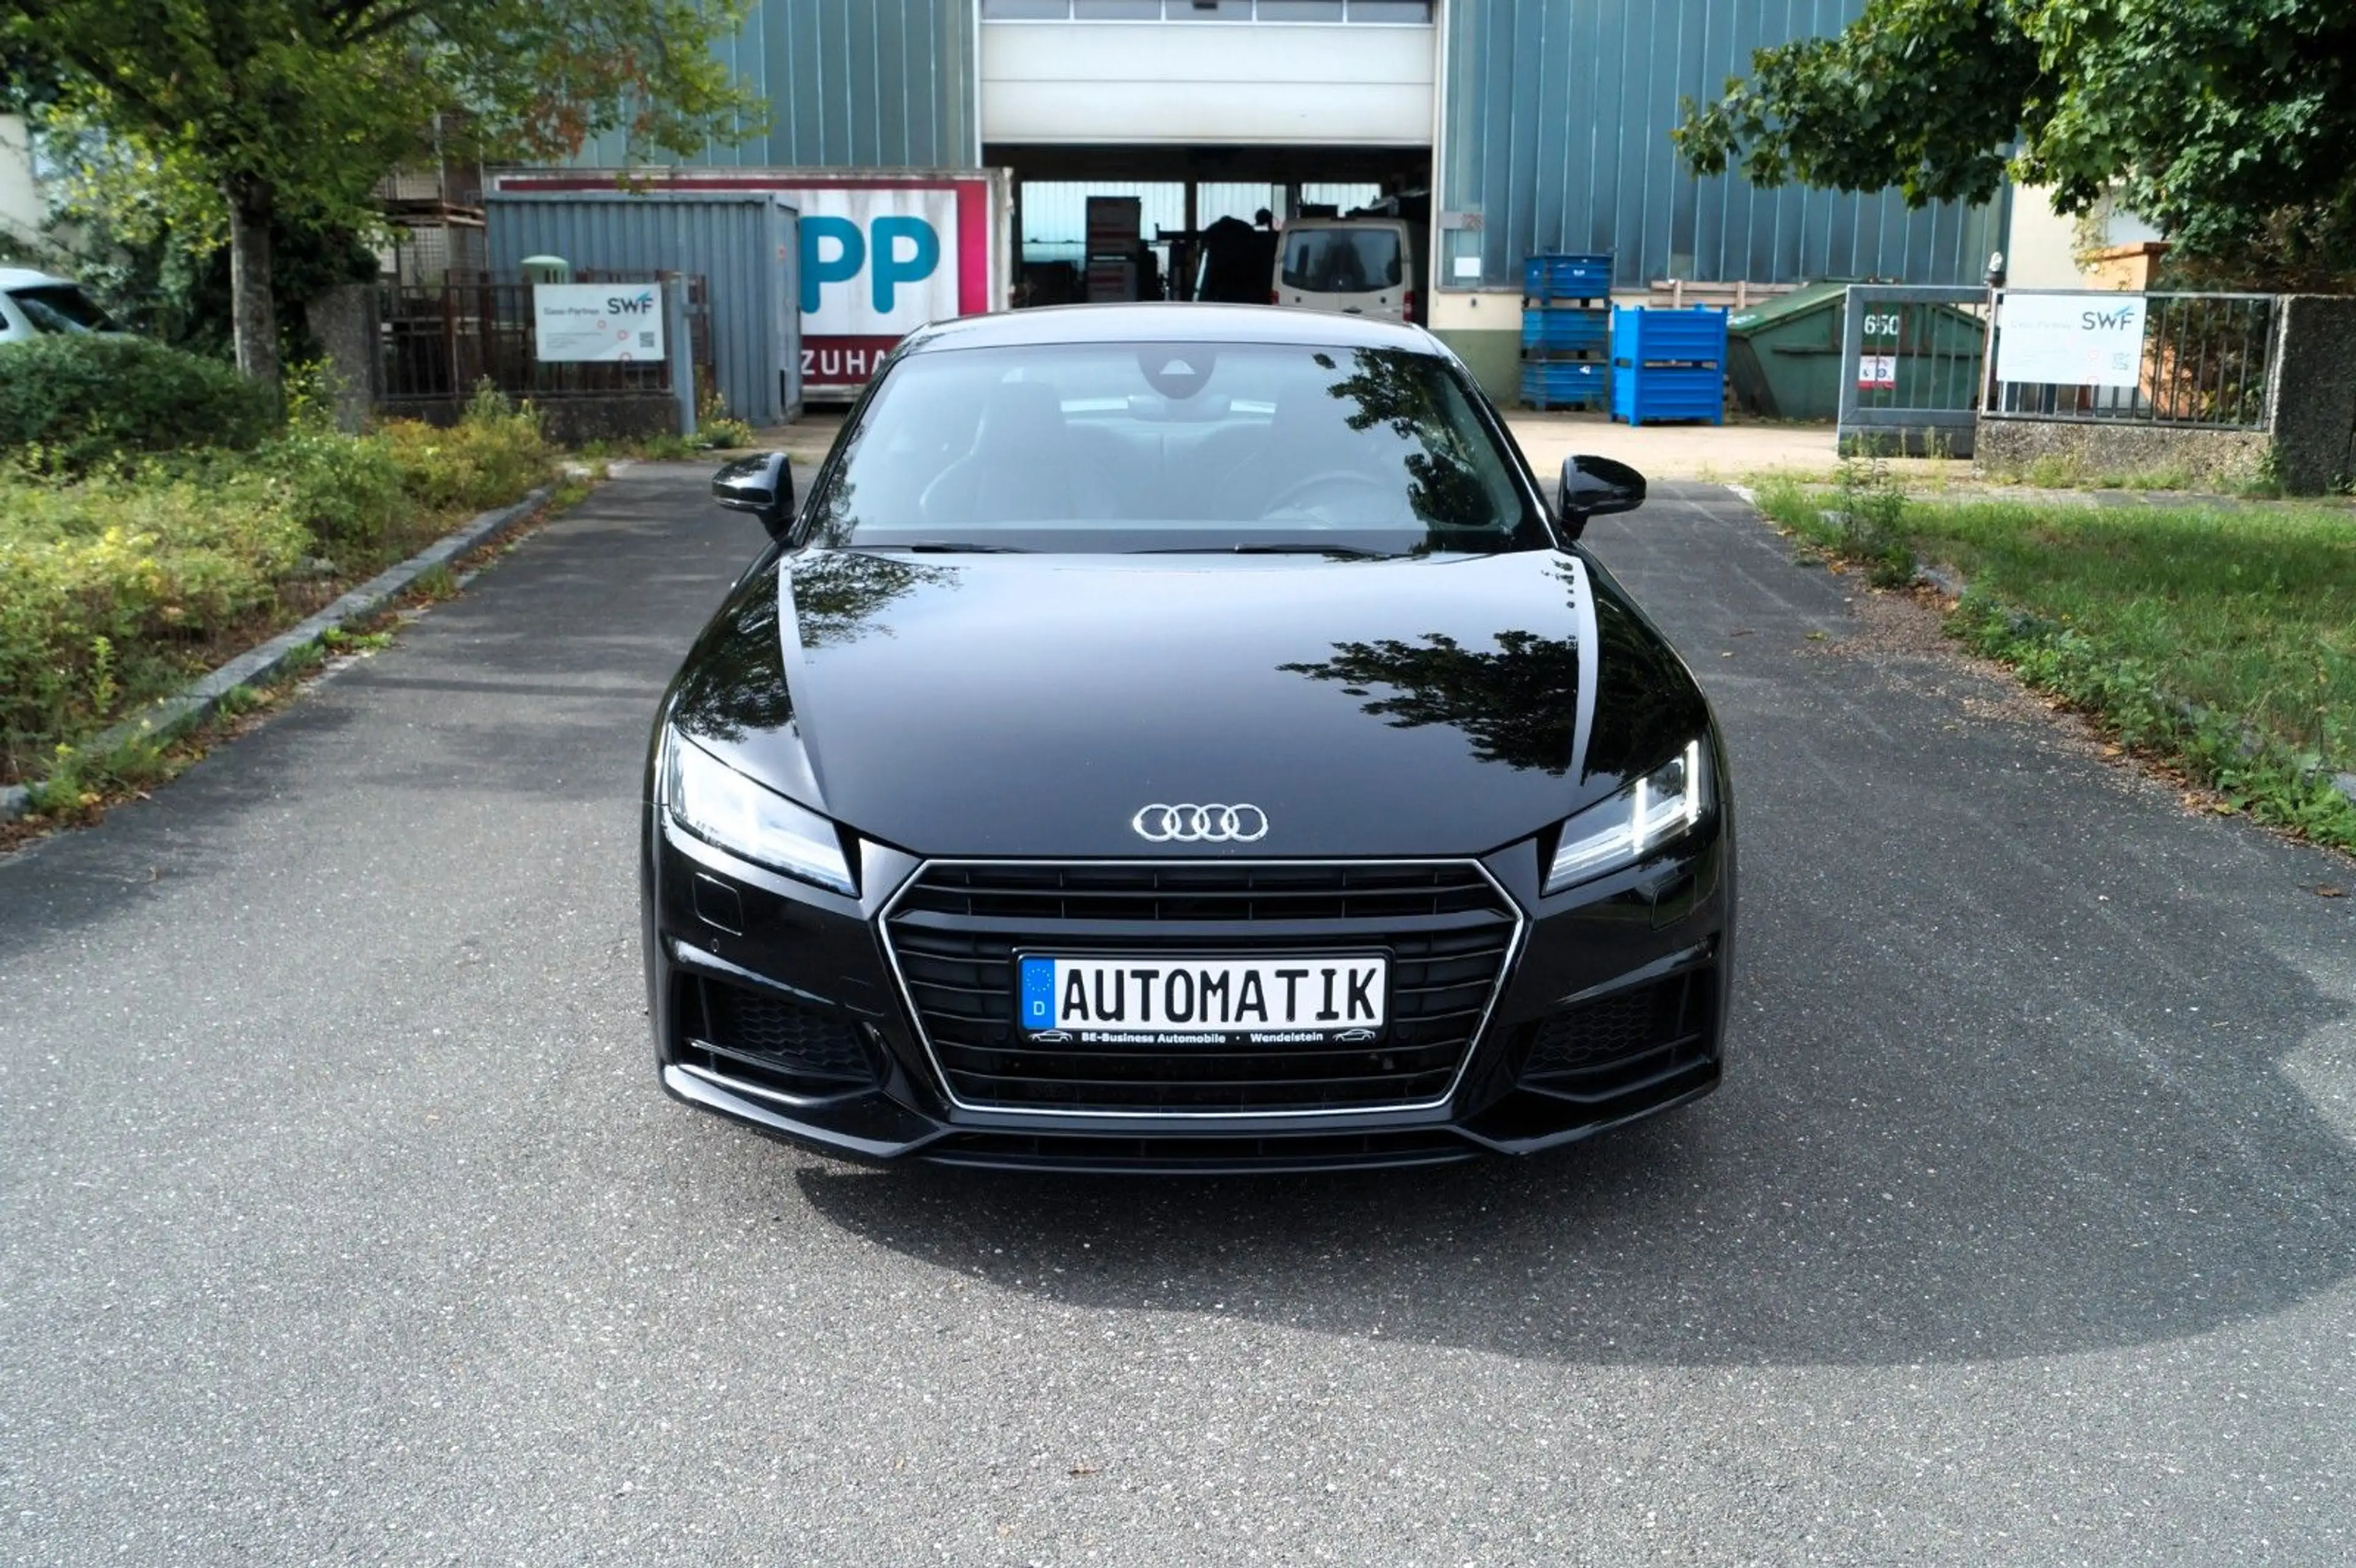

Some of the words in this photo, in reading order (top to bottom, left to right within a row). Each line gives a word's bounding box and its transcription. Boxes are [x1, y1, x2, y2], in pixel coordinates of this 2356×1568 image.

[607, 297, 653, 315] SWF
[2081, 311, 2135, 331] SWF
[1061, 967, 1377, 1023] AUTOMATIK
[1033, 1001, 1045, 1016] D
[1081, 1032, 1154, 1043] BE-Business
[1157, 1033, 1226, 1043] Automobile
[1250, 1032, 1323, 1043] Wendelstein
